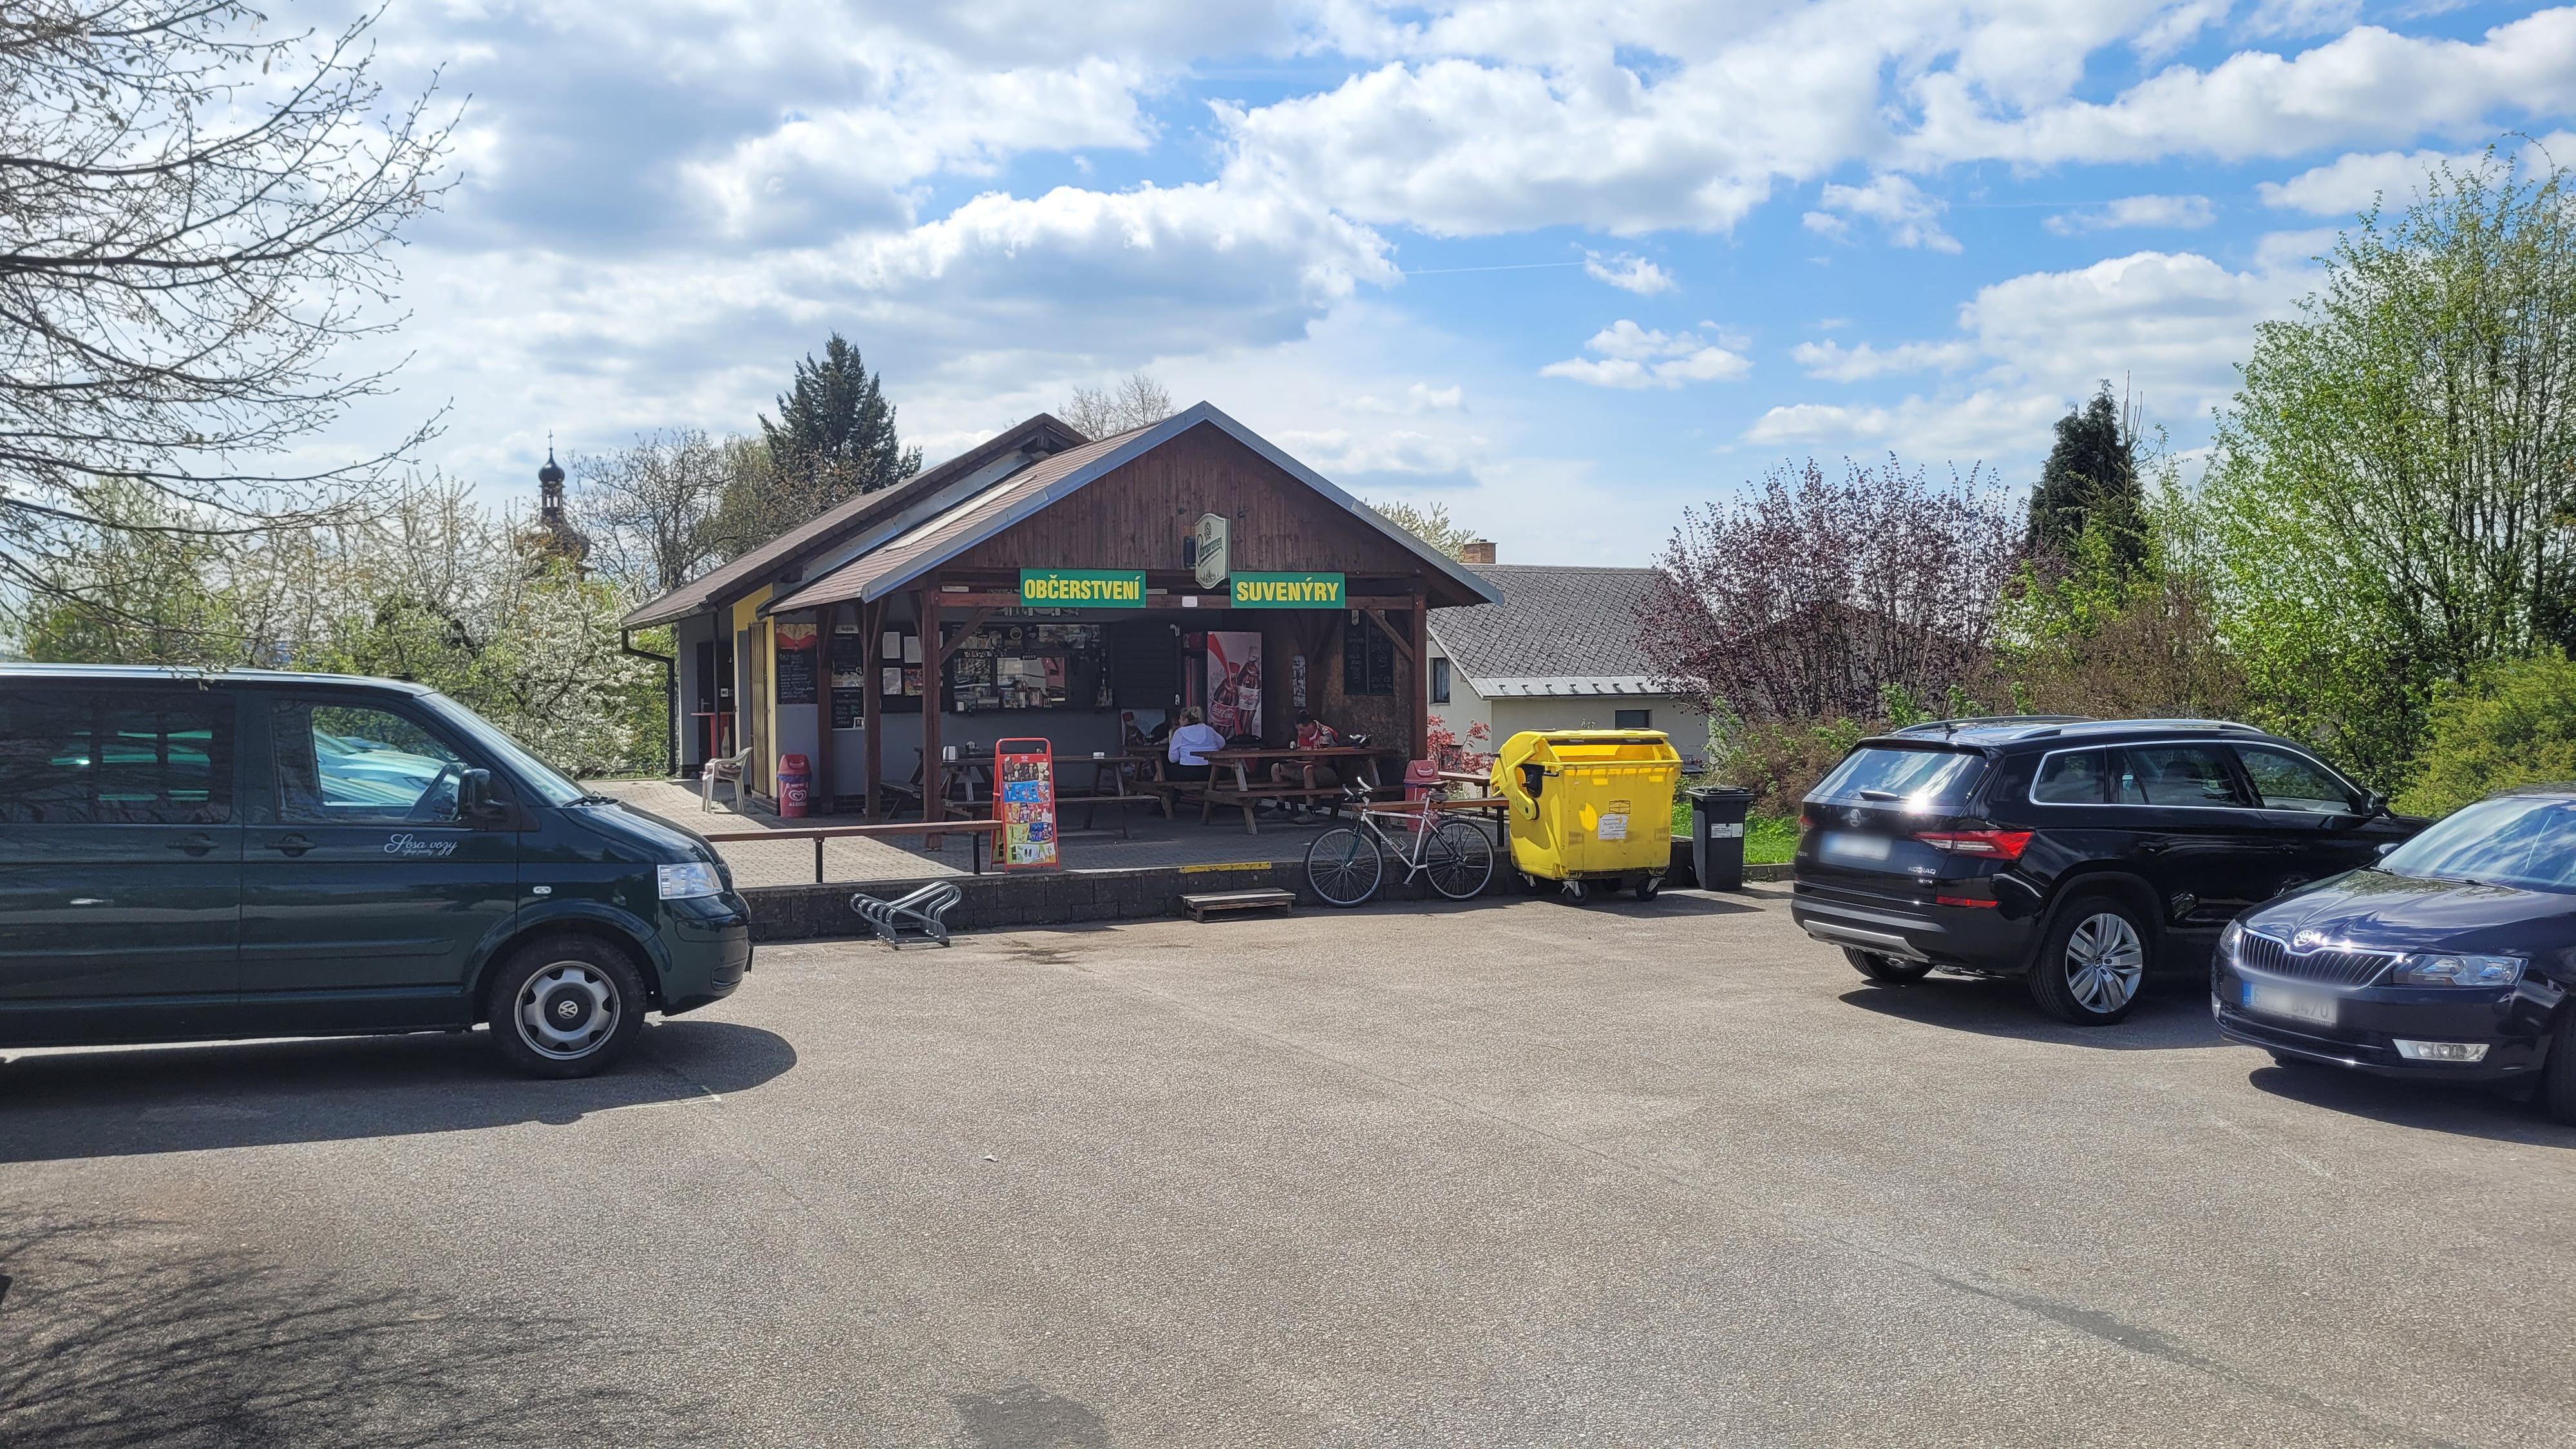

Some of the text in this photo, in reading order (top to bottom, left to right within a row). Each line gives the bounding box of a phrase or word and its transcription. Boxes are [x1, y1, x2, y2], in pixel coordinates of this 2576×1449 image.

[1024, 574, 1141, 600] OBČERSTVENÍ
[1236, 576, 1339, 601] SUVENÝRY
[430, 841, 458, 856] vozy
